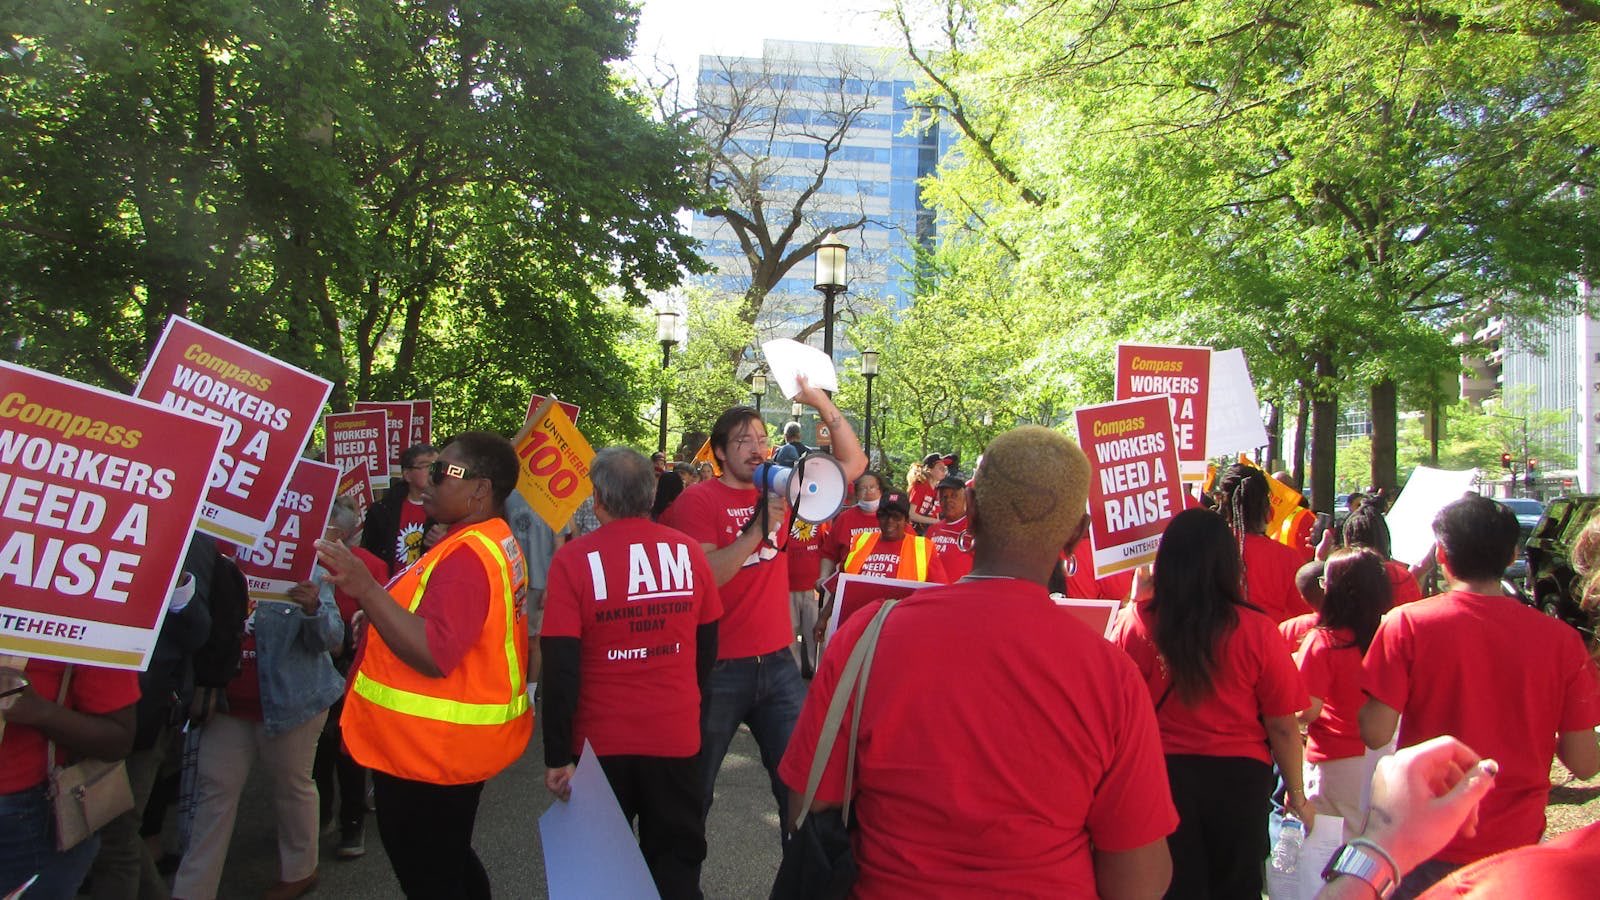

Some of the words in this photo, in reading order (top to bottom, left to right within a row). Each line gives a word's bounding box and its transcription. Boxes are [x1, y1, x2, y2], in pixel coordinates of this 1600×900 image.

[184, 343, 272, 392] Compass
[1132, 356, 1184, 374] Compass
[172, 363, 292, 431] WORKERS
[1130, 375, 1199, 395] WORKERS
[0, 392, 143, 449] Compass
[1180, 398, 1194, 419] A
[333, 428, 379, 441] WORKERS
[392, 430, 400, 442] A
[414, 427, 422, 439] A
[1093, 416, 1145, 437] Compass
[242, 429, 270, 461] A
[334, 441, 365, 456] NEED
[368, 440, 377, 453] A
[1095, 432, 1165, 463] WORKERS
[519, 431, 579, 499] 100
[1100, 460, 1150, 495] NEED
[1154, 457, 1167, 483] A
[1104, 487, 1172, 533] RAISE
[111, 502, 149, 546] A
[280, 514, 300, 538] A
[0, 530, 142, 603] AISE
[587, 550, 607, 600] I
[628, 542, 694, 595] AM
[862, 563, 886, 572] NEED
[886, 564, 893, 573] A
[595, 605, 643, 622] MAKING
[647, 601, 693, 616] HISTORY
[0, 613, 87, 640] TEHERE!
[629, 619, 665, 633] TODAY
